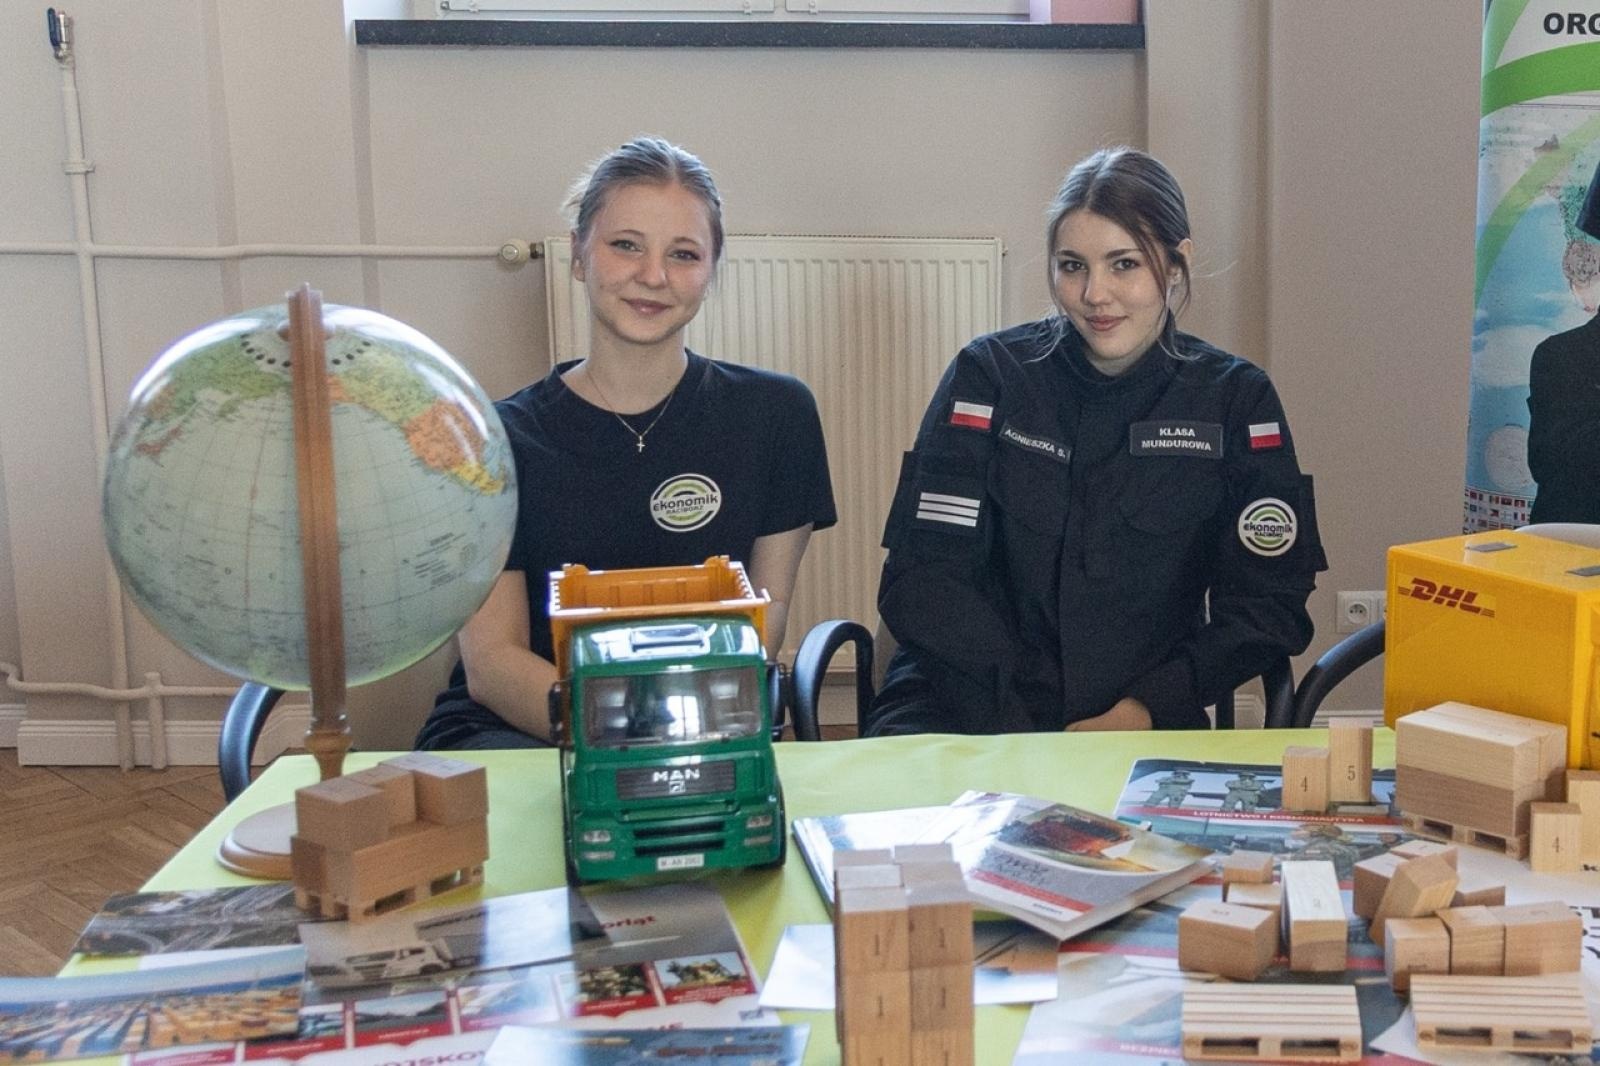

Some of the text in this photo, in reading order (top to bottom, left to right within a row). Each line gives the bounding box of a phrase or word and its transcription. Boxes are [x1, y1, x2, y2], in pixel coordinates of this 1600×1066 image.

[1158, 427, 1196, 437] KLASA
[1004, 428, 1067, 459] AGNIESZKA S.
[1141, 439, 1212, 451] MUNDUROWA
[653, 493, 719, 513] ekonomik
[1243, 521, 1294, 533] ekonomik
[1410, 577, 1482, 615] DHL
[652, 768, 701, 783] MAN
[1347, 765, 1357, 781] 5
[1300, 775, 1310, 793] 4
